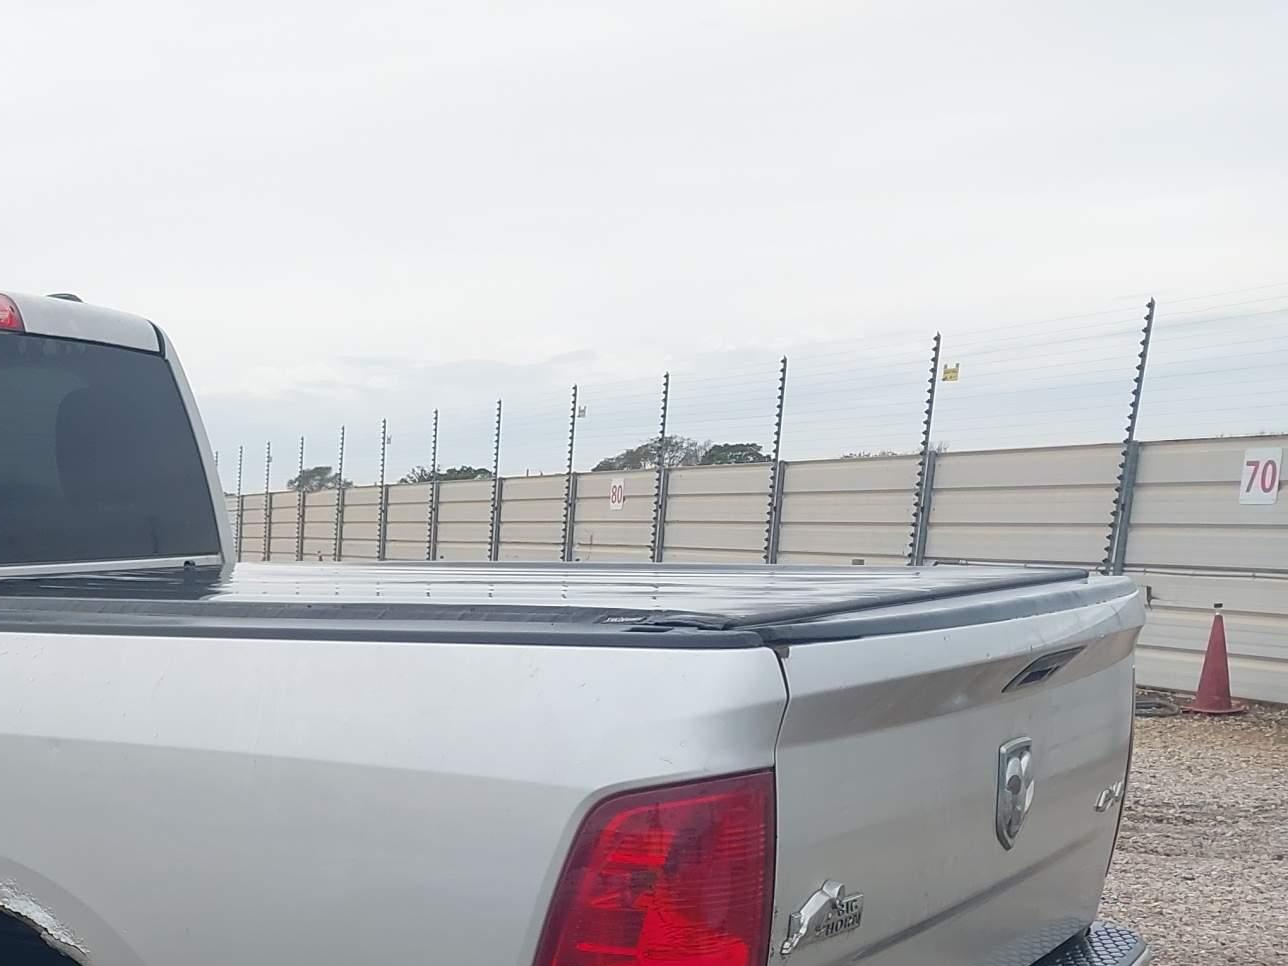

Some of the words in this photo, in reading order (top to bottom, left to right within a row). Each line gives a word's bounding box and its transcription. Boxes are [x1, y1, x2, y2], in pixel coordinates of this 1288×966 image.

[1245, 459, 1278, 494] 70
[611, 485, 623, 504] 80
[824, 912, 862, 936] HORN
